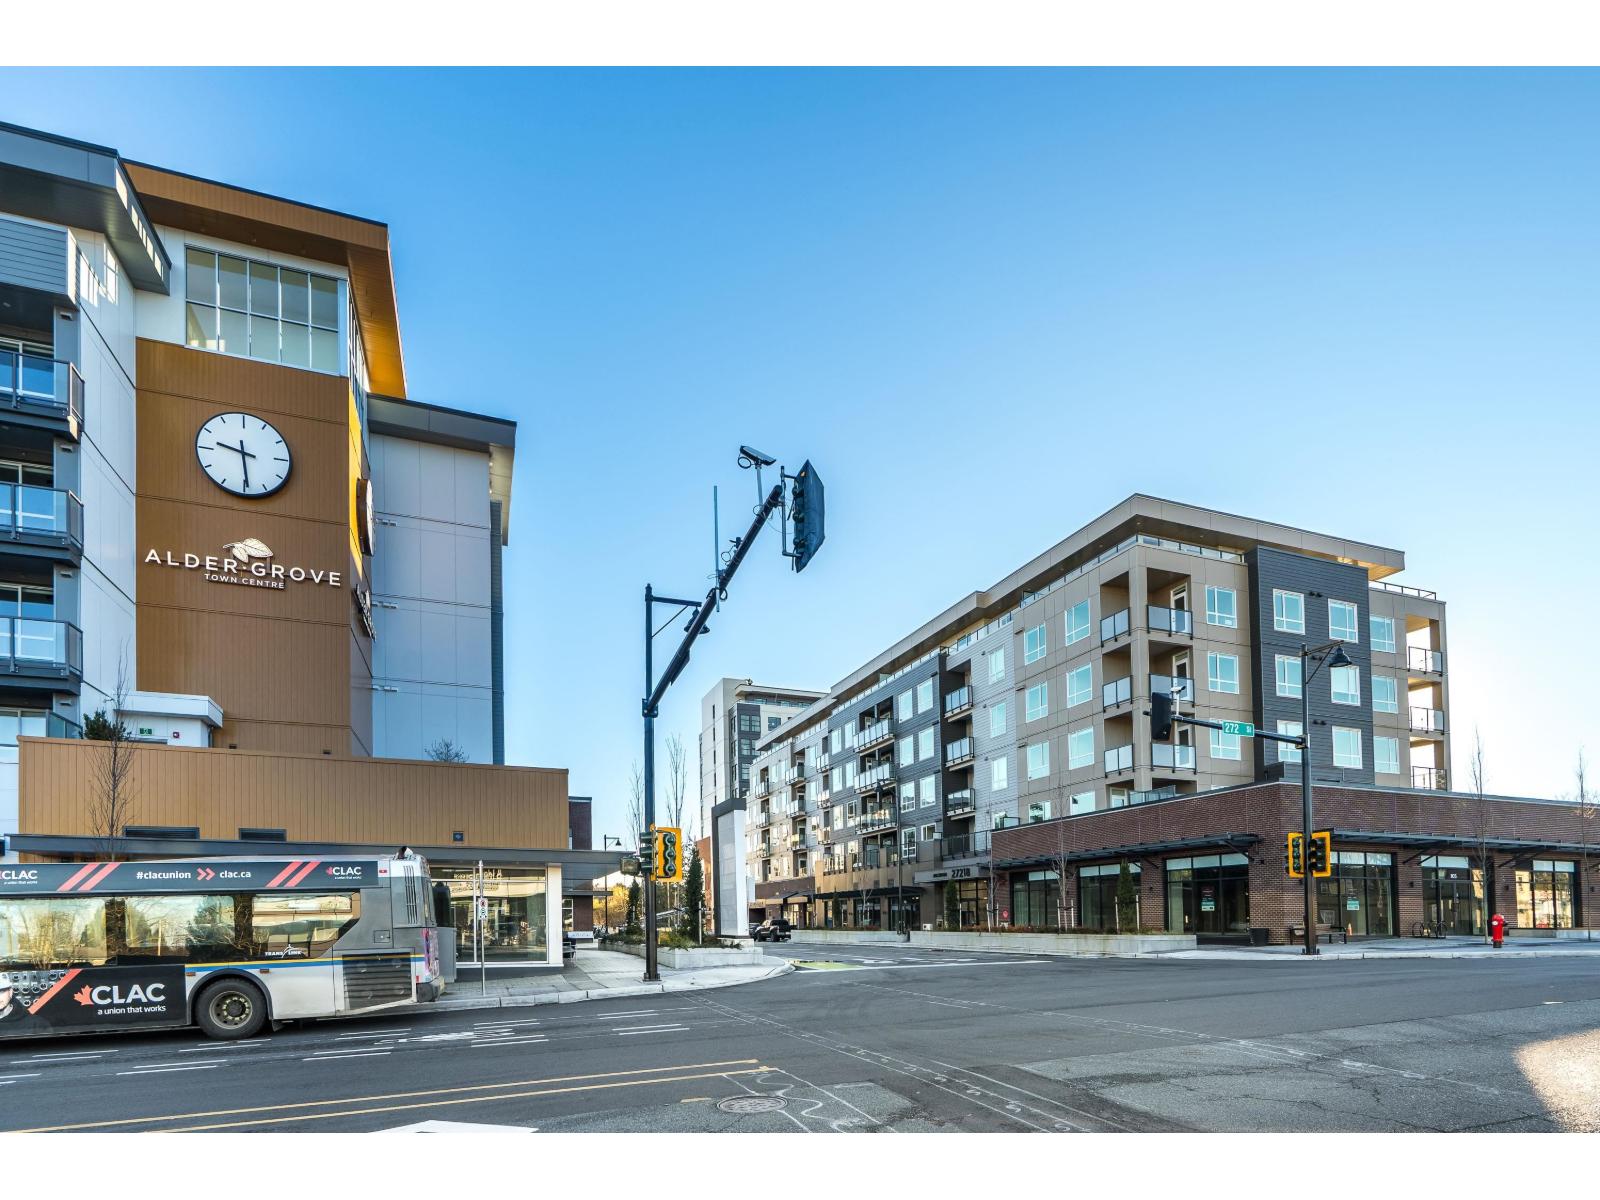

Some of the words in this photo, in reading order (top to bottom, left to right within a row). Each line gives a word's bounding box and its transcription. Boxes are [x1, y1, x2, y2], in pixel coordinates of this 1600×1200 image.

[204, 573, 238, 584] TOWN
[242, 578, 285, 589] CENTRE
[1225, 722, 1240, 734] 272
[1, 870, 38, 880] CLAC
[136, 871, 191, 879] #clacunion
[219, 870, 252, 878] clac.ca
[332, 866, 362, 876] CLAC
[91, 983, 166, 1005] CLAC
[97, 1008, 103, 1016] a
[104, 1007, 126, 1015] union
[127, 1006, 143, 1014] that
